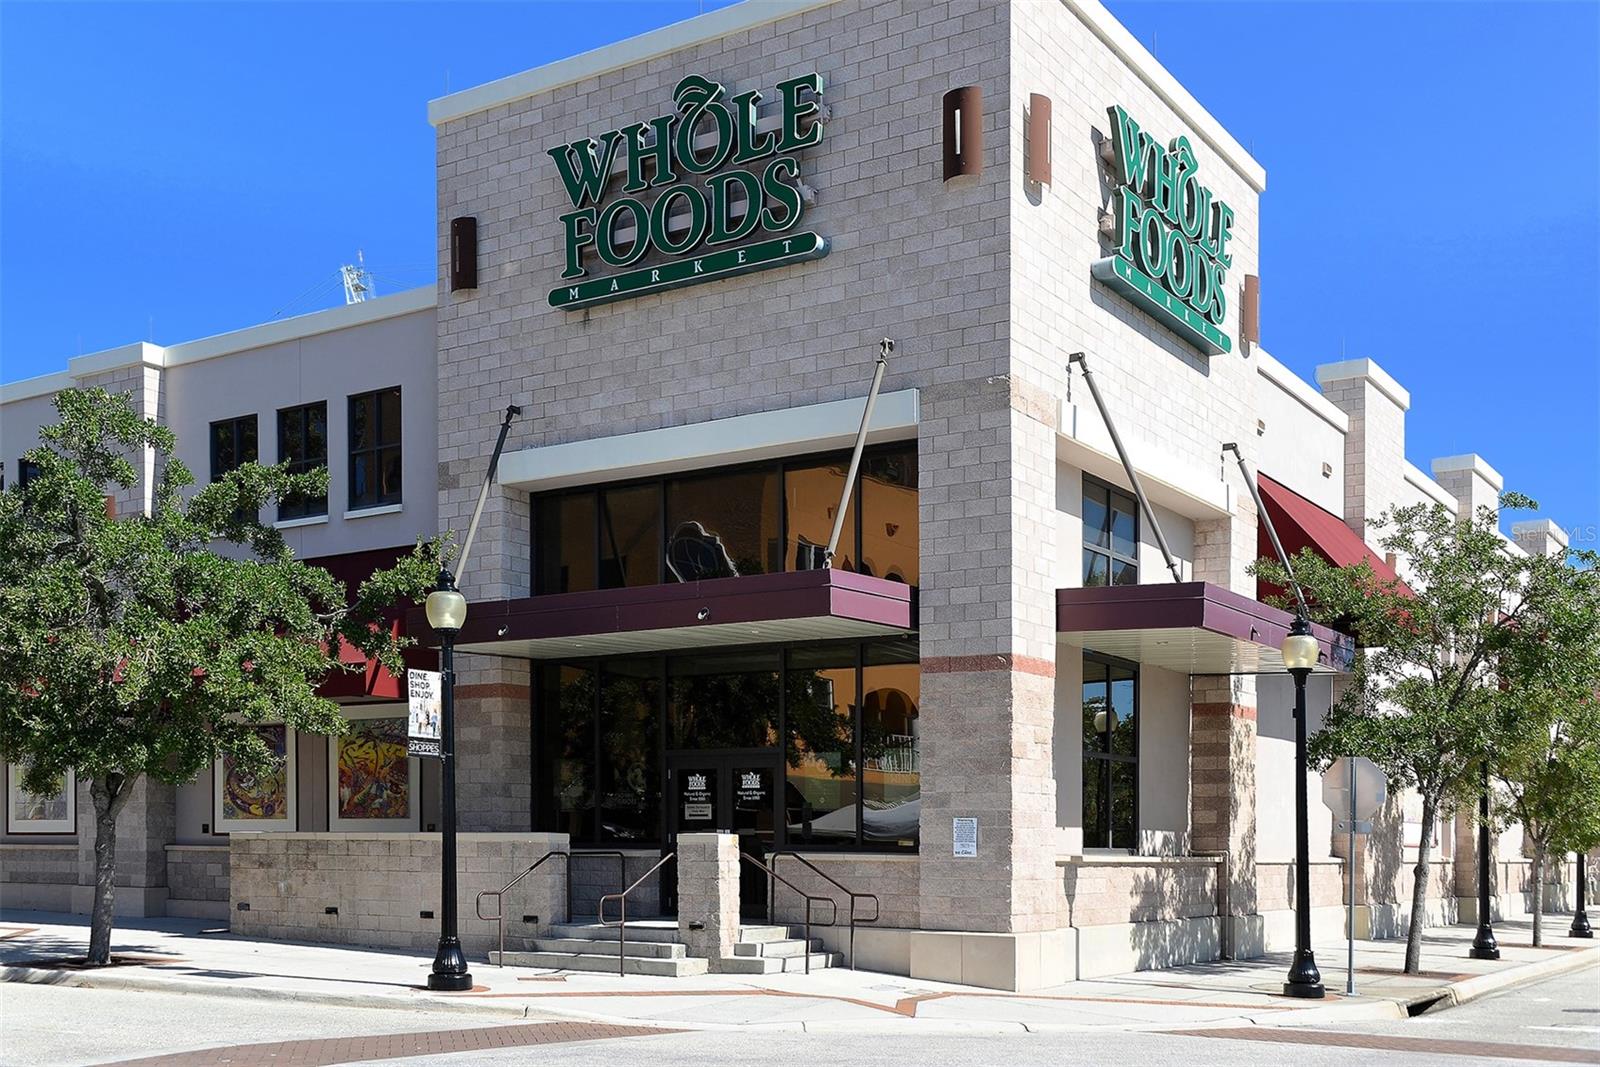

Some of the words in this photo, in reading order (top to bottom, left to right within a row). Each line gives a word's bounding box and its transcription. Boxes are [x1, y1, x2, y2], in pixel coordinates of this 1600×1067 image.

[547, 72, 824, 208] WHOLE
[559, 157, 804, 279] FOODS
[1107, 104, 1234, 270] WHOLE
[568, 240, 793, 301] MARKET
[1113, 185, 1226, 325] FOODS
[1125, 267, 1225, 346] MARKET
[408, 742, 440, 753] SHOPPES
[688, 774, 706, 782] WHOLE
[741, 771, 761, 781] WHOLE
